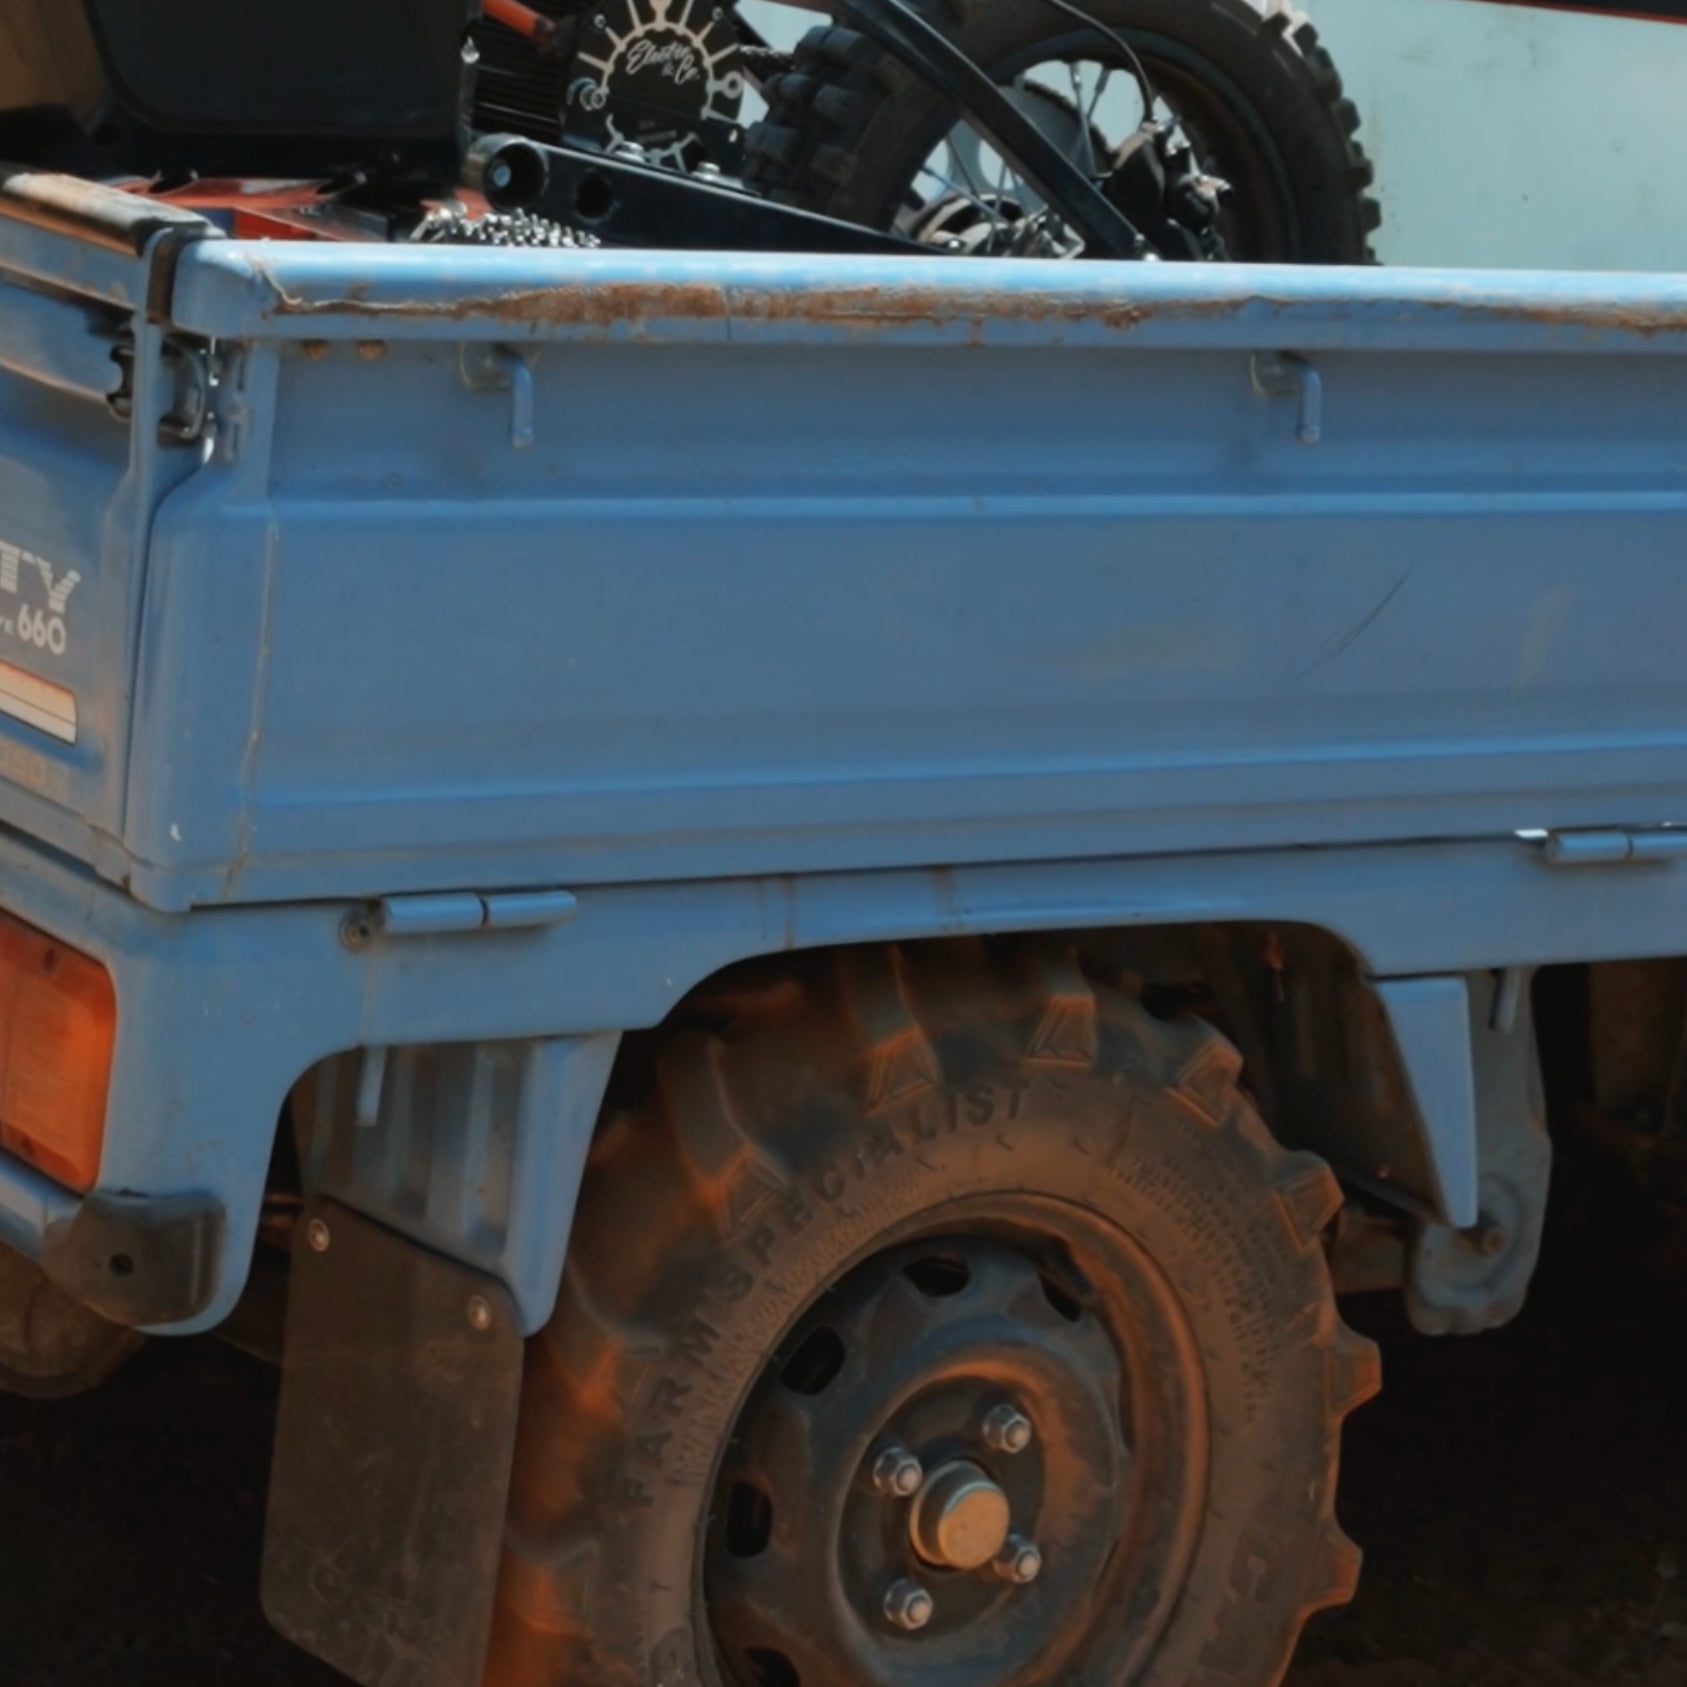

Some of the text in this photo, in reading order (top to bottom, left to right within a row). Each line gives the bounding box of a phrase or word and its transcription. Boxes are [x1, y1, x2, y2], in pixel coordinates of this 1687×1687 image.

[17, 603, 66, 655] 660
[624, 1318, 721, 1508] FARM
[724, 1080, 1032, 1303] SPECIALIST
